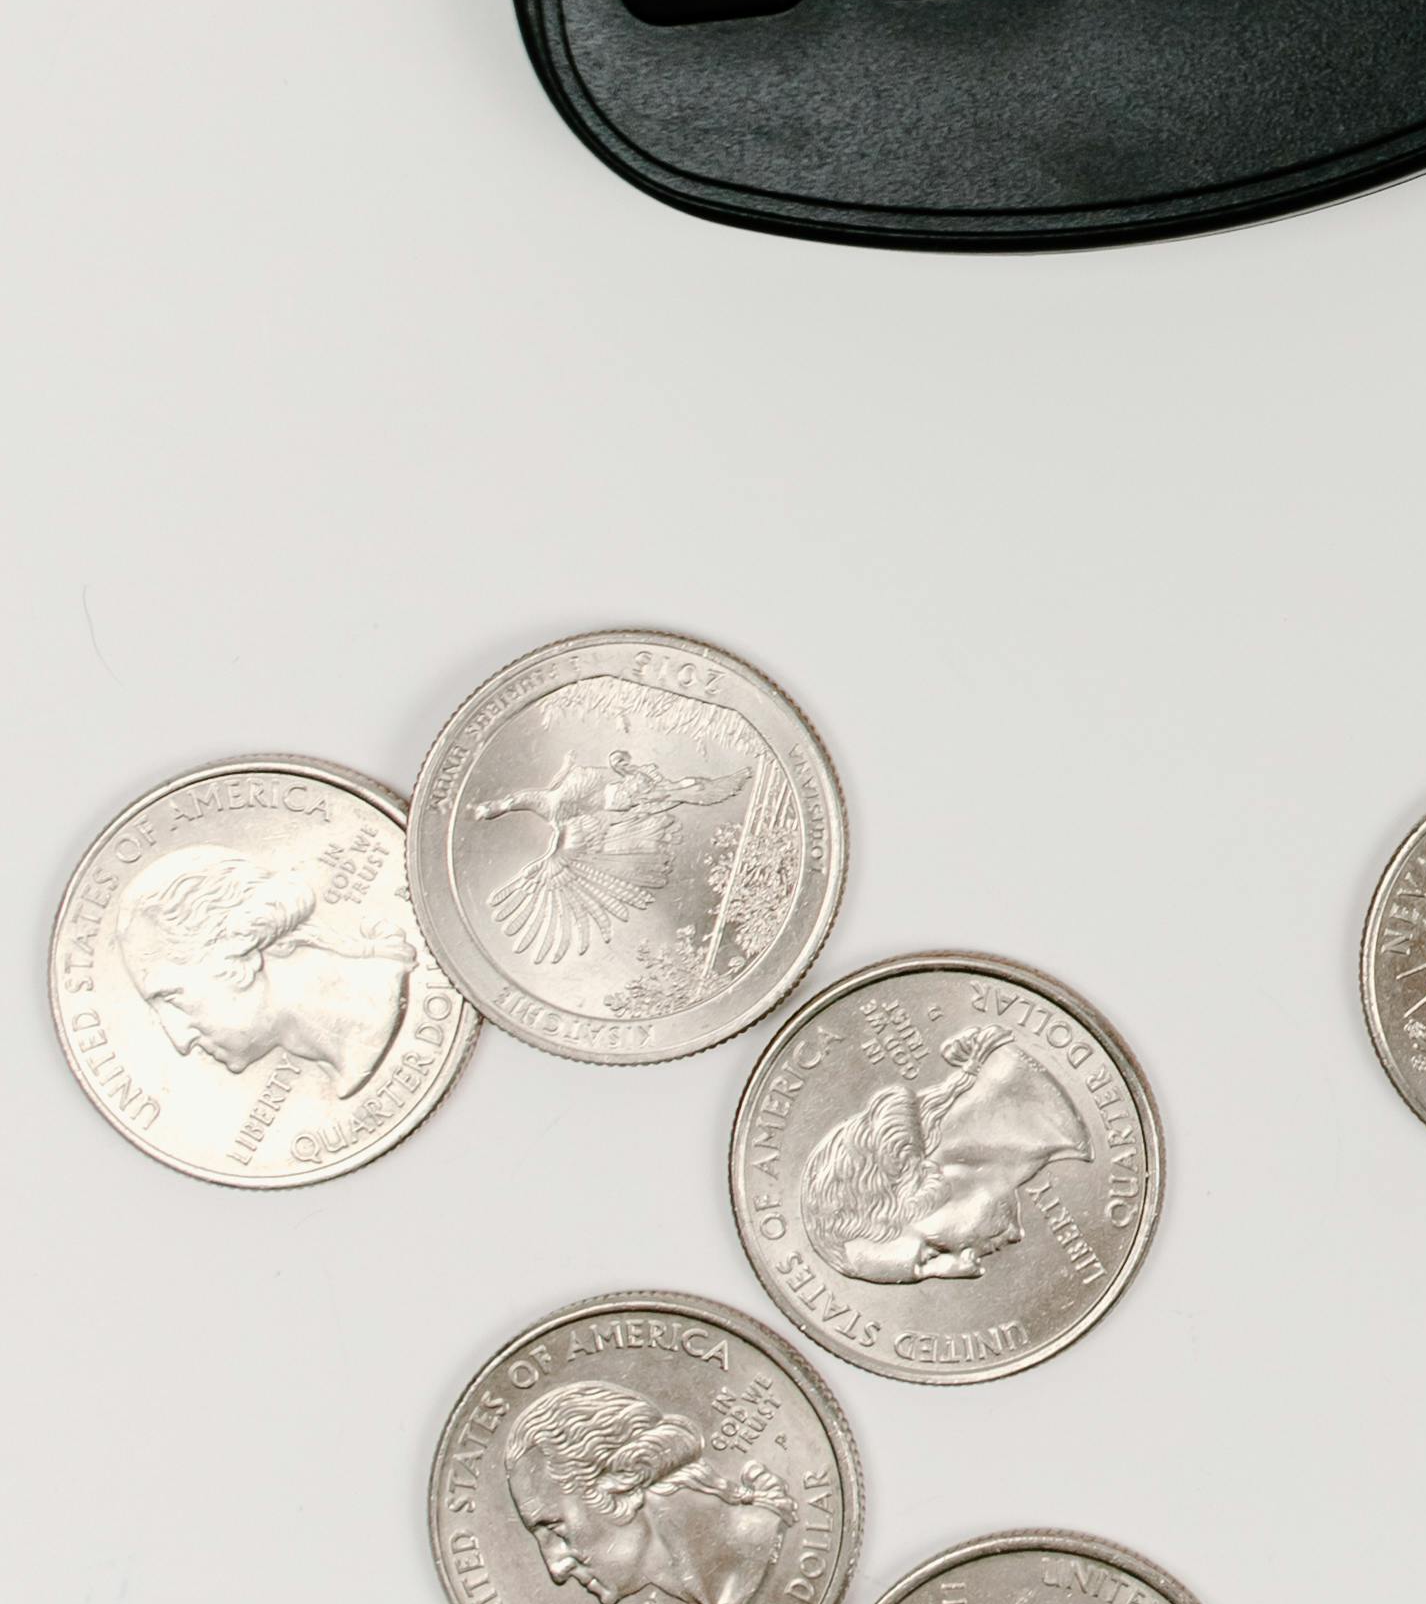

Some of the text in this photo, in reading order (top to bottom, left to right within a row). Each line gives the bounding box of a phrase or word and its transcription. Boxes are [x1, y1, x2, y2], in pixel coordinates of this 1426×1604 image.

[633, 650, 727, 696] 2015
[318, 841, 347, 869] IN
[344, 843, 391, 905] TRUST
[354, 824, 379, 853] WE
[63, 780, 333, 1132] UNITED STATES OF AMERICA
[226, 1052, 303, 1166] LIBERTY
[288, 1050, 435, 1165] QUARTER
[969, 979, 1141, 1230] QUARTER DOLLAR
[751, 1025, 1032, 1364] UNITED STATES OF AMERICA
[1026, 1180, 1108, 1285] LIBERTY
[447, 1391, 511, 1514] STATES
[507, 1344, 552, 1390] OF
[566, 1319, 732, 1372] AMERICA
[710, 1386, 739, 1415] IN
[729, 1394, 783, 1456] TRUST
[788, 1467, 835, 1604] DOLLAR
